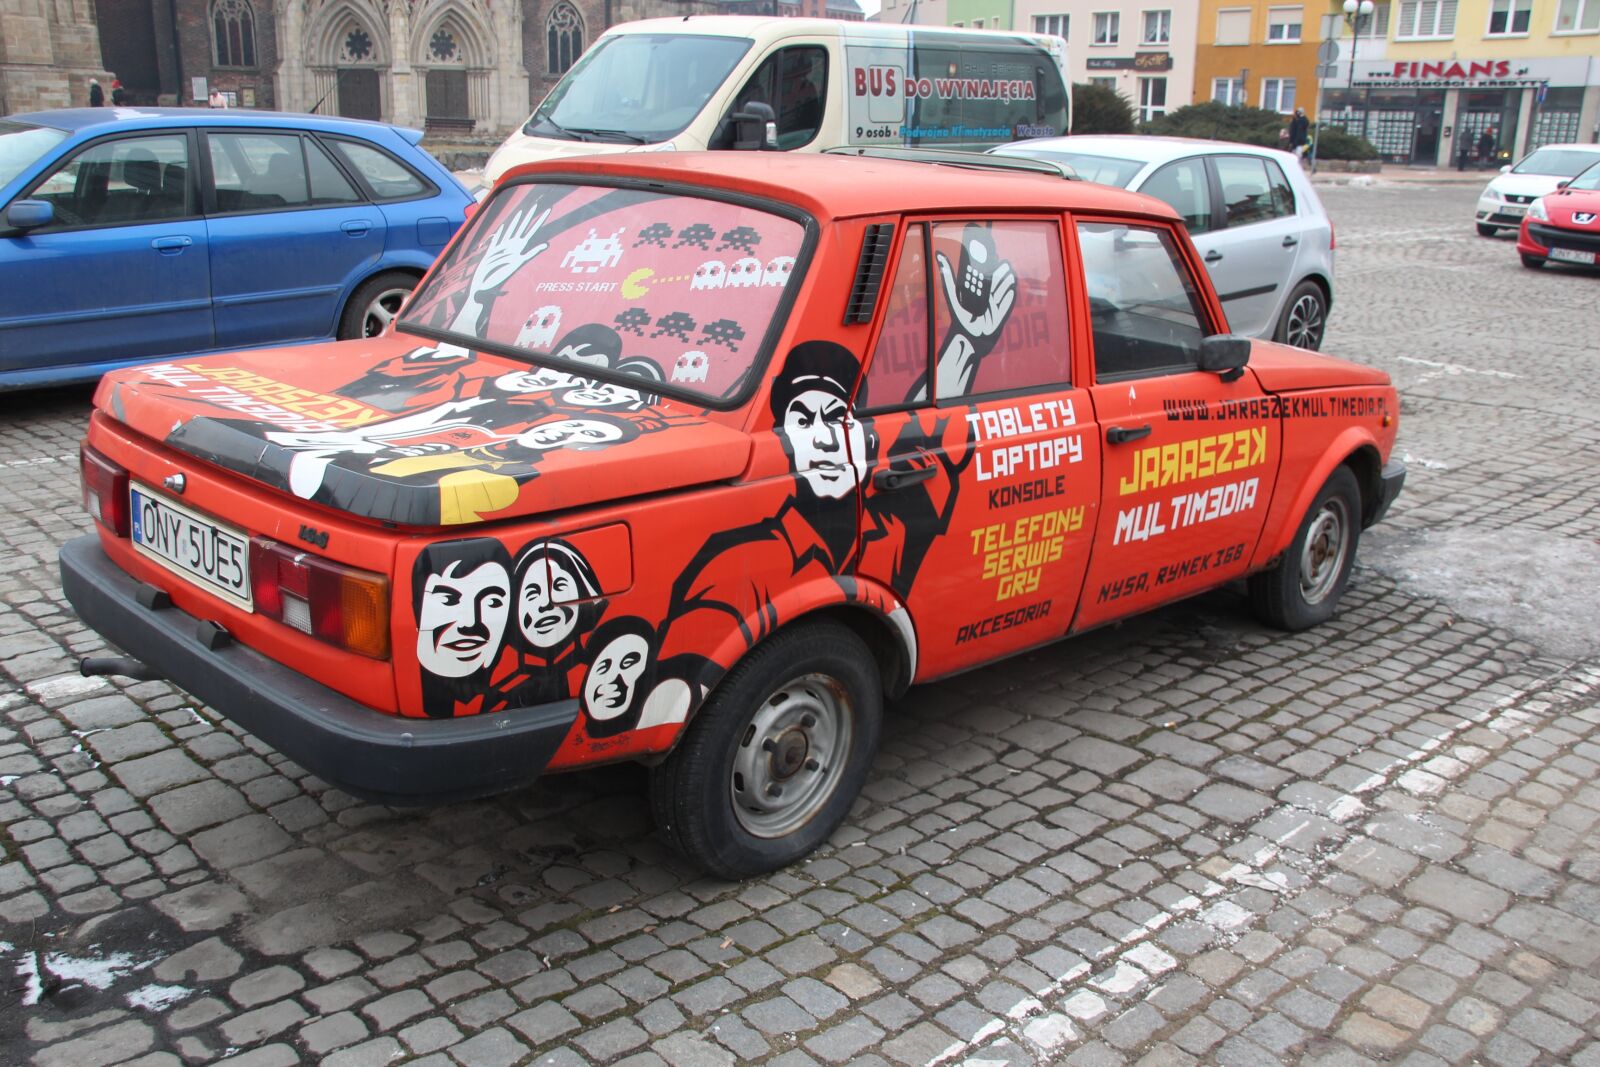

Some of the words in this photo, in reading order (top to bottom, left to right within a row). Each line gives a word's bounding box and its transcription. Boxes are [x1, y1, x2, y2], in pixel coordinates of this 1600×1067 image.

[854, 67, 896, 97] BUS
[904, 77, 932, 99] DO
[935, 77, 1036, 104] WYNAJĘCIA
[856, 126, 863, 138] 9
[866, 125, 891, 138] osób
[535, 281, 575, 293] PRESS
[575, 281, 618, 293] START
[965, 399, 1076, 442] TABLETY
[976, 435, 1082, 481] LAPTOPY
[988, 475, 1065, 510] KONSOLE
[143, 502, 181, 559] ONY
[189, 524, 243, 589] 5UE5
[971, 505, 1084, 555] TELEFONY
[982, 535, 1064, 580] SERWIS
[1096, 572, 1149, 604] NYSA,
[1154, 553, 1212, 587] RYNEK
[996, 567, 1041, 602] GRY
[955, 599, 1052, 645] AKCESORIA
